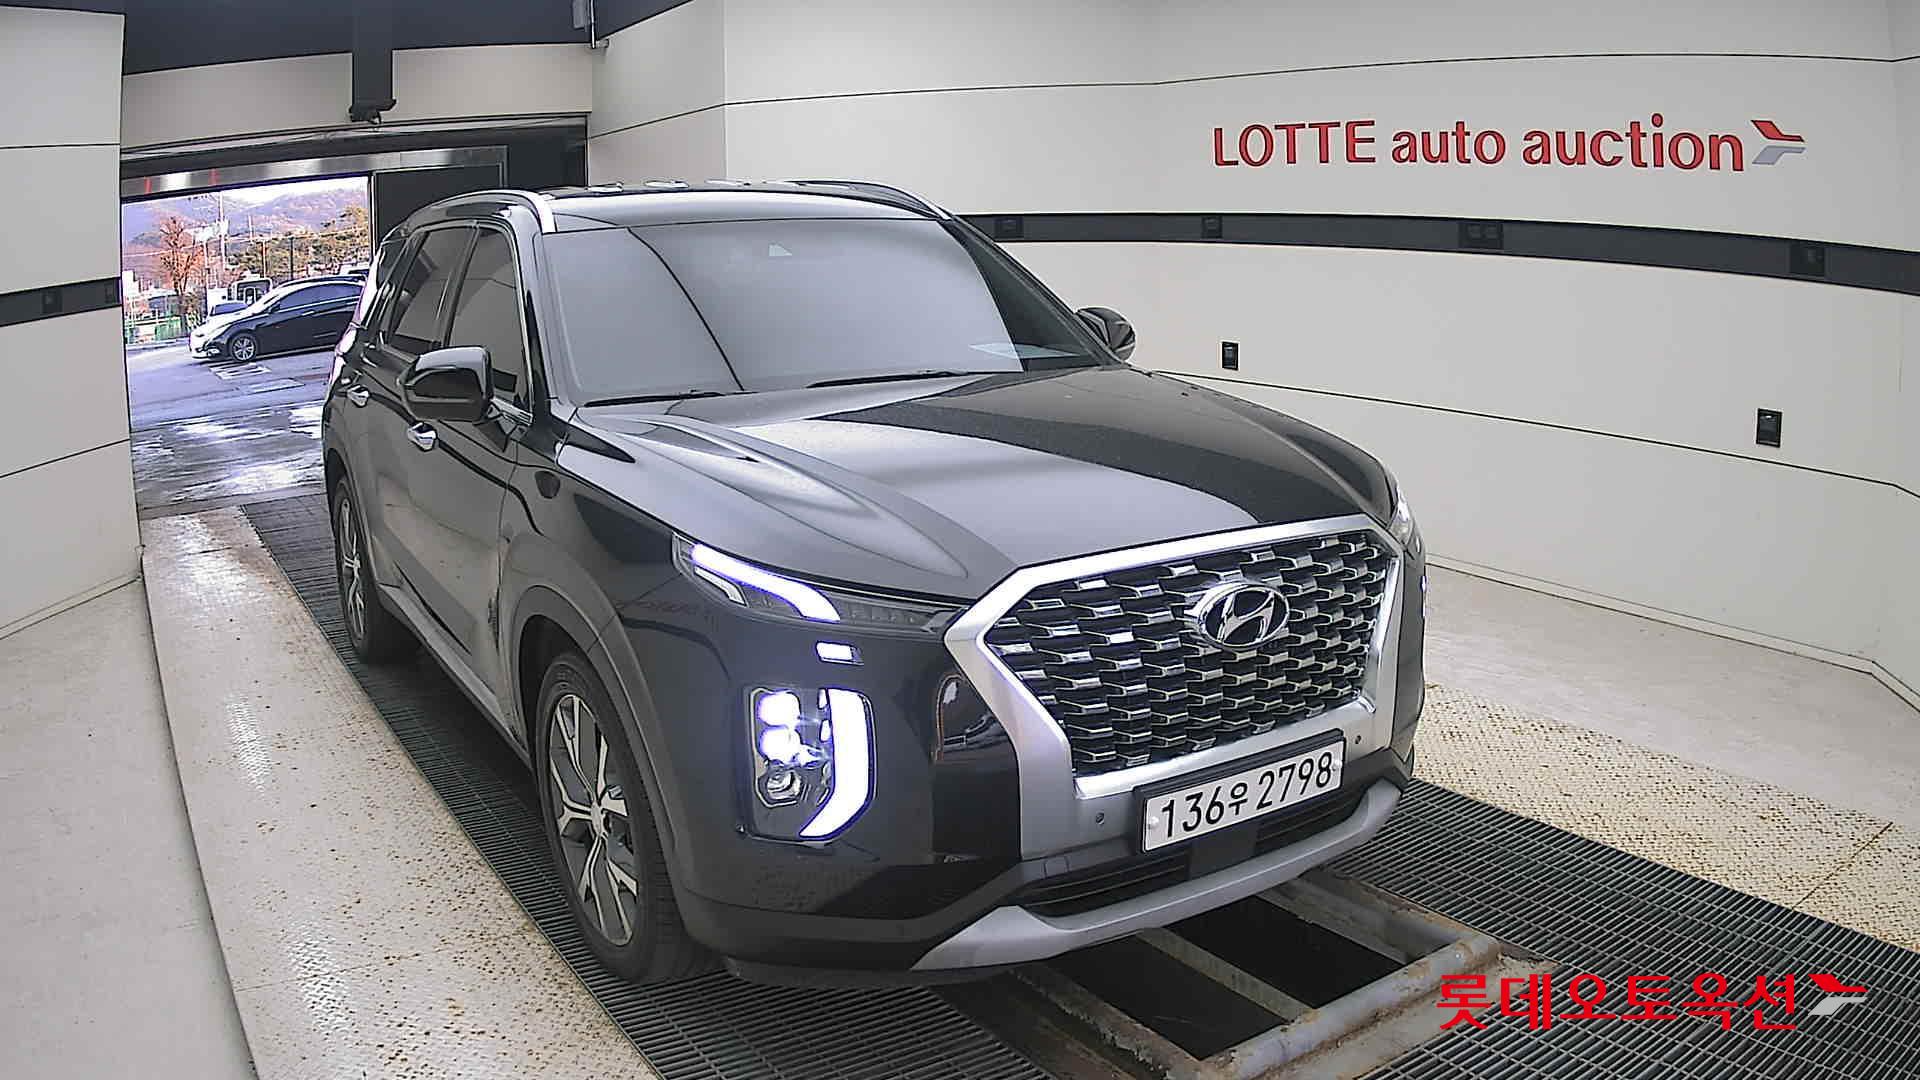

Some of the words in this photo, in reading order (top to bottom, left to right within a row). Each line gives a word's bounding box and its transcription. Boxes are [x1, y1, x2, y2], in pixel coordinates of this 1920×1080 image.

[1213, 120, 1376, 167] LOTTE
[1391, 120, 1507, 165] auto
[1522, 113, 1745, 172] auction
[1256, 751, 1333, 811] 2798
